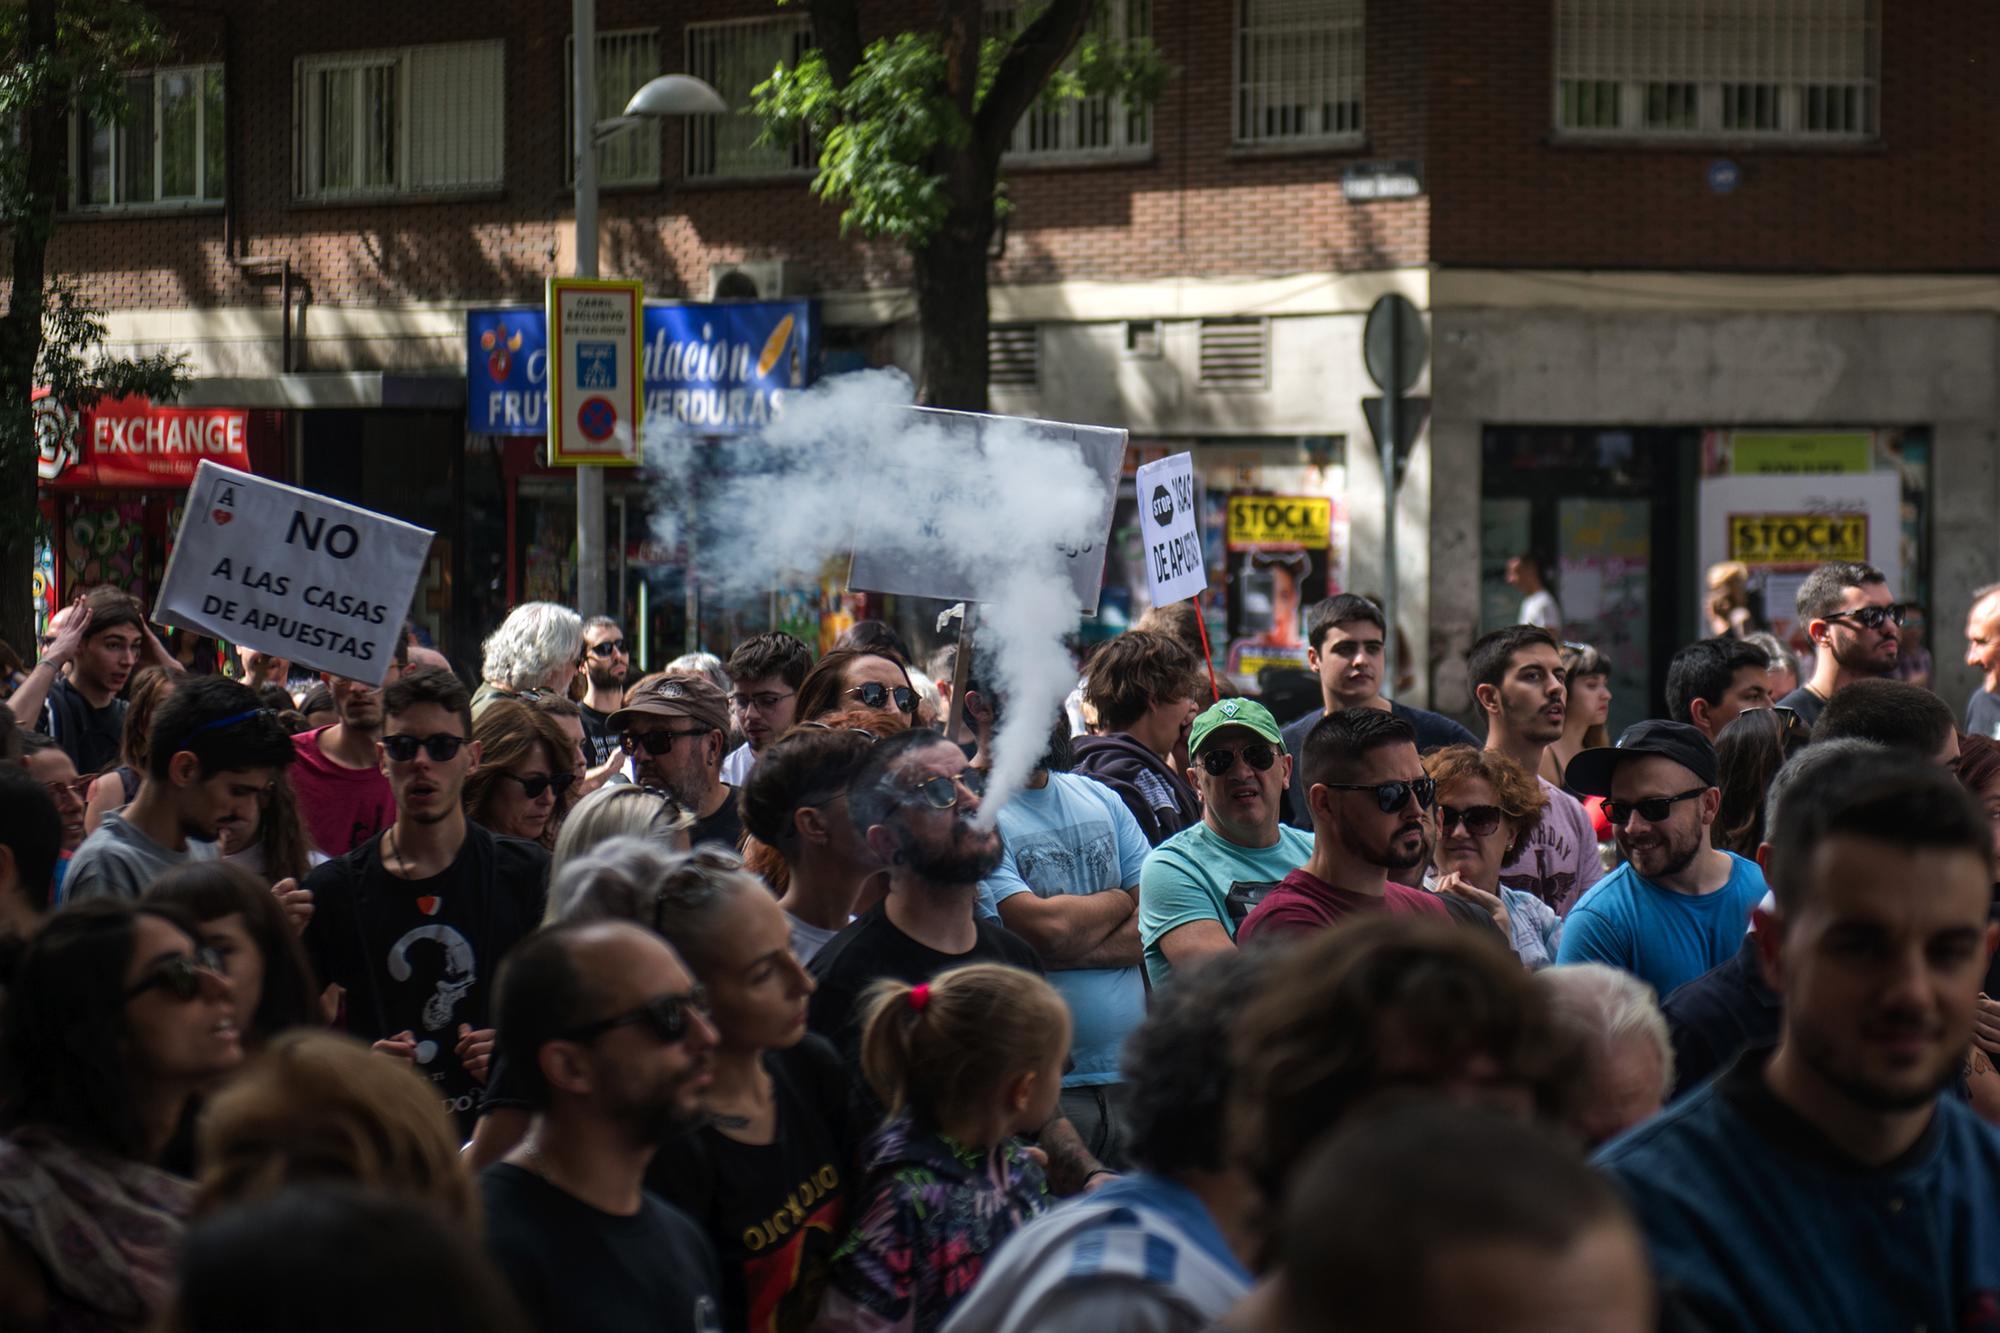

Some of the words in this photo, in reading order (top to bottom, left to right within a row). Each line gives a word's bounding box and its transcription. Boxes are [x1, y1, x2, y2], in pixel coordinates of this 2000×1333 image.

[488, 390, 548, 426] FRU
[94, 416, 243, 454] EXCHANGE
[217, 487, 235, 507] A
[1153, 495, 1172, 516] STOP
[285, 510, 359, 560] NO
[1738, 522, 1860, 548] STOCK!
[1153, 543, 1171, 584] DE
[212, 557, 233, 580] A
[241, 566, 290, 597] LAS
[303, 586, 387, 625] CASAS
[202, 594, 238, 622] DE
[242, 608, 376, 661] APUESTAS
